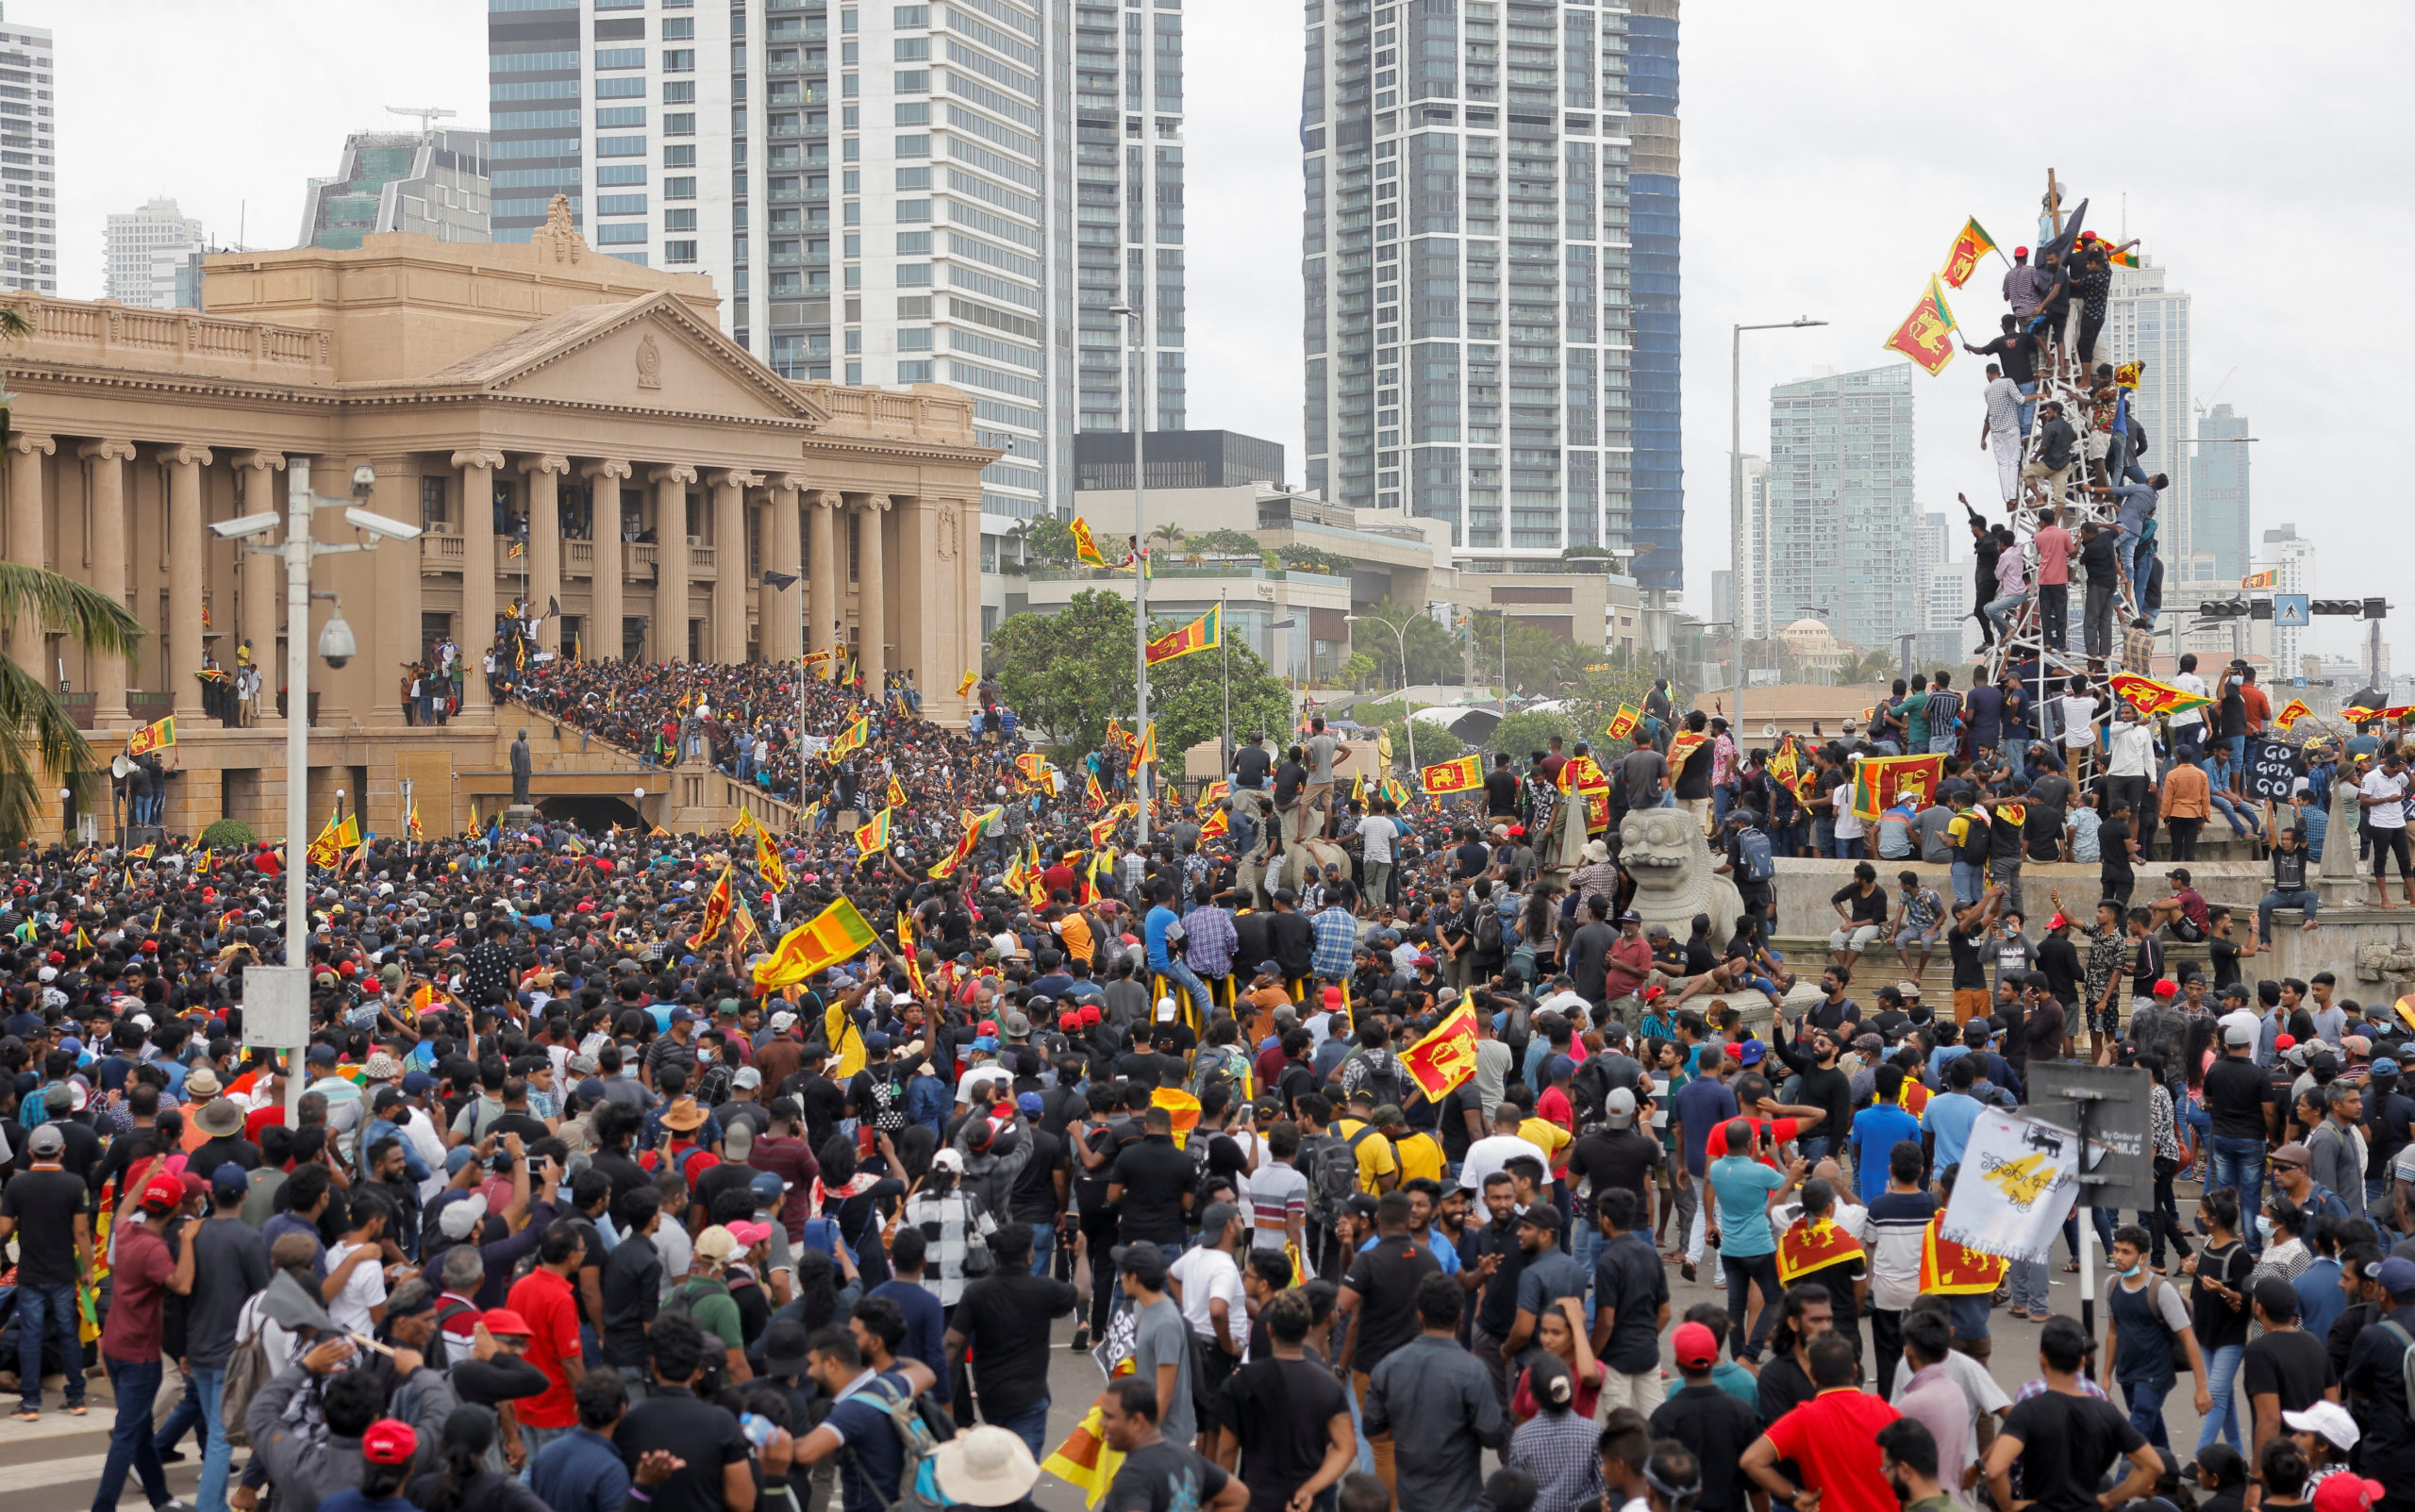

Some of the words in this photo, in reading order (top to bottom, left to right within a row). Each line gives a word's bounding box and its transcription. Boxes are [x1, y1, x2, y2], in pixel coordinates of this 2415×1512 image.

[2264, 745, 2291, 760] GO
[2256, 761, 2294, 778] GOTA
[2256, 778, 2288, 796] GO
[2102, 1131, 2112, 1141] By
[2113, 1132, 2133, 1141] Order
[2134, 1133, 2142, 1142] of
